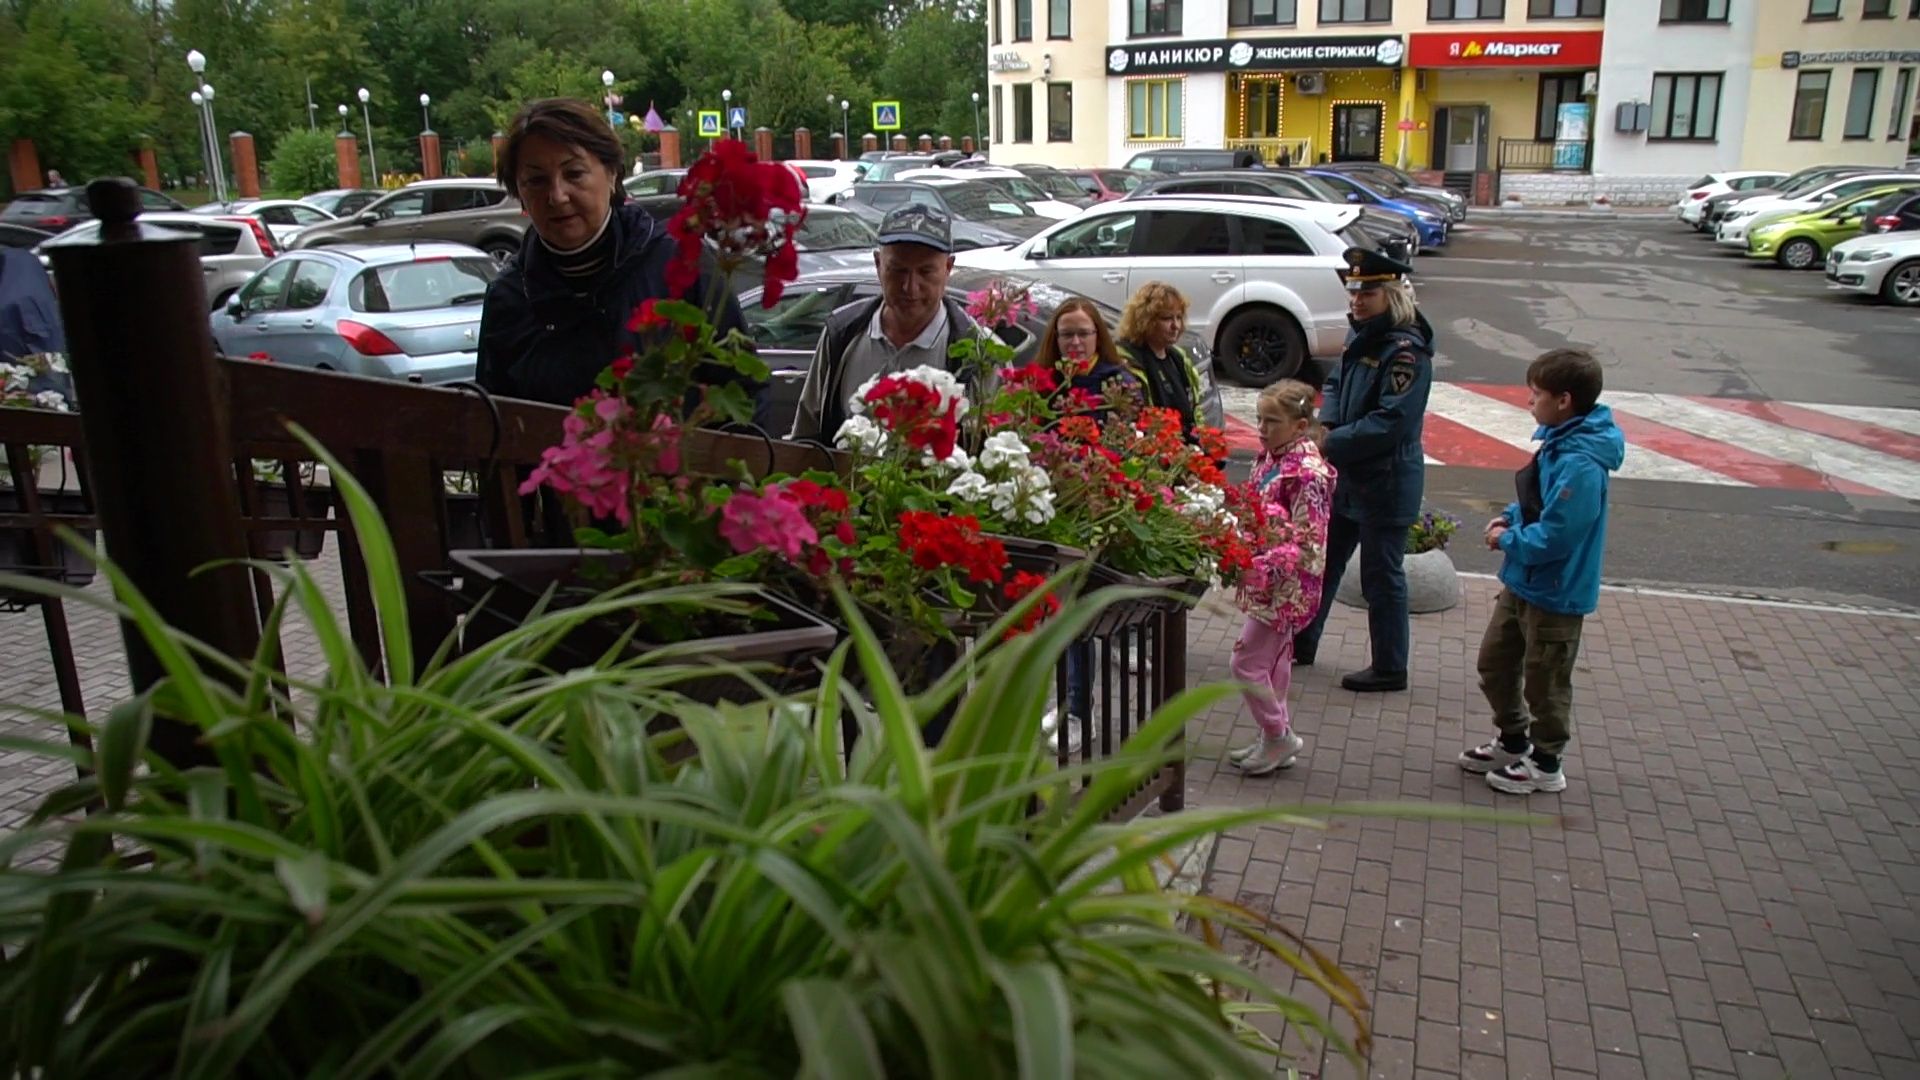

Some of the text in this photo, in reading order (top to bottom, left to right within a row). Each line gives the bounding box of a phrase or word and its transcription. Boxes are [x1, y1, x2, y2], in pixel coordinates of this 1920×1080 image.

[1134, 47, 1224, 66] МАНИКЮР
[1255, 45, 1376, 59] ЖЕНСКИЕ СТРИЖКИ
[1449, 42, 1460, 56] Я
[1484, 42, 1562, 57] Маркет
